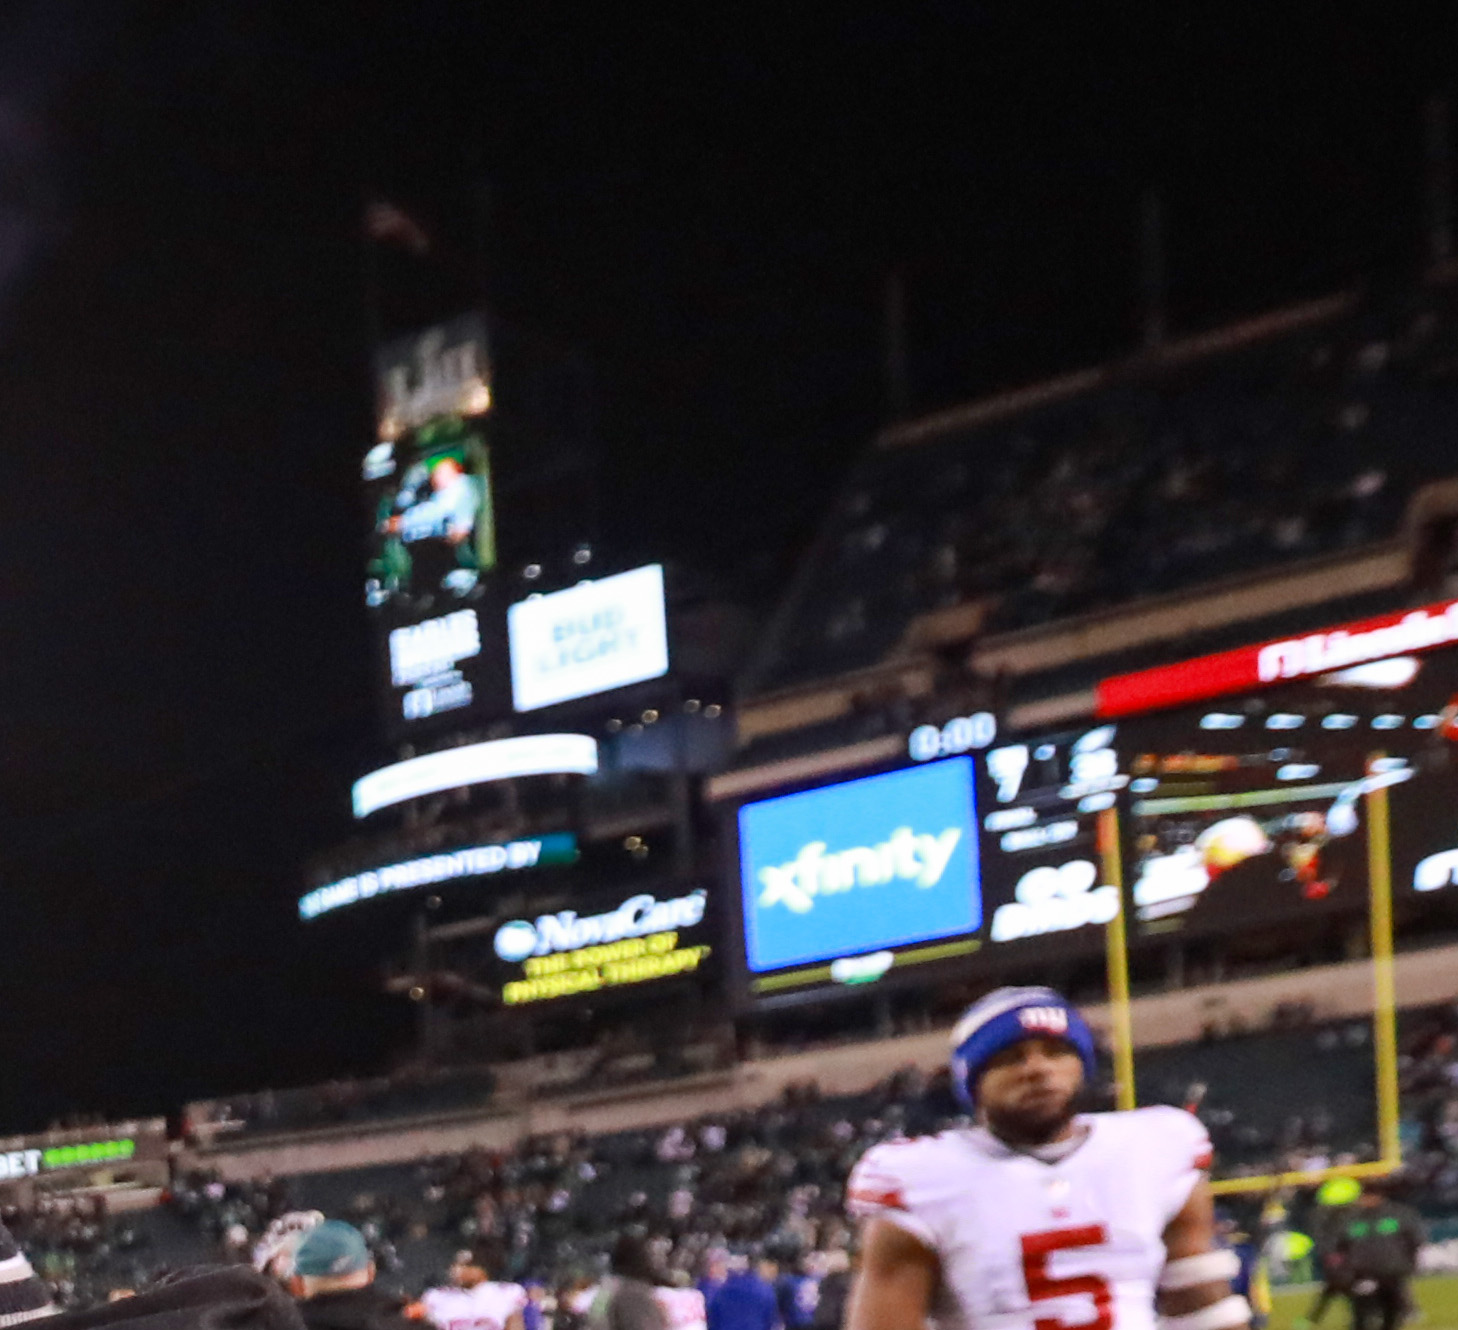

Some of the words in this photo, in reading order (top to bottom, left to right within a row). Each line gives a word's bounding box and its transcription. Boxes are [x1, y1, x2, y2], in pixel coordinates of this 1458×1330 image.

[376, 845, 507, 891] PRESENTED
[758, 826, 961, 914] xfinity
[533, 888, 708, 957] NovaCare
